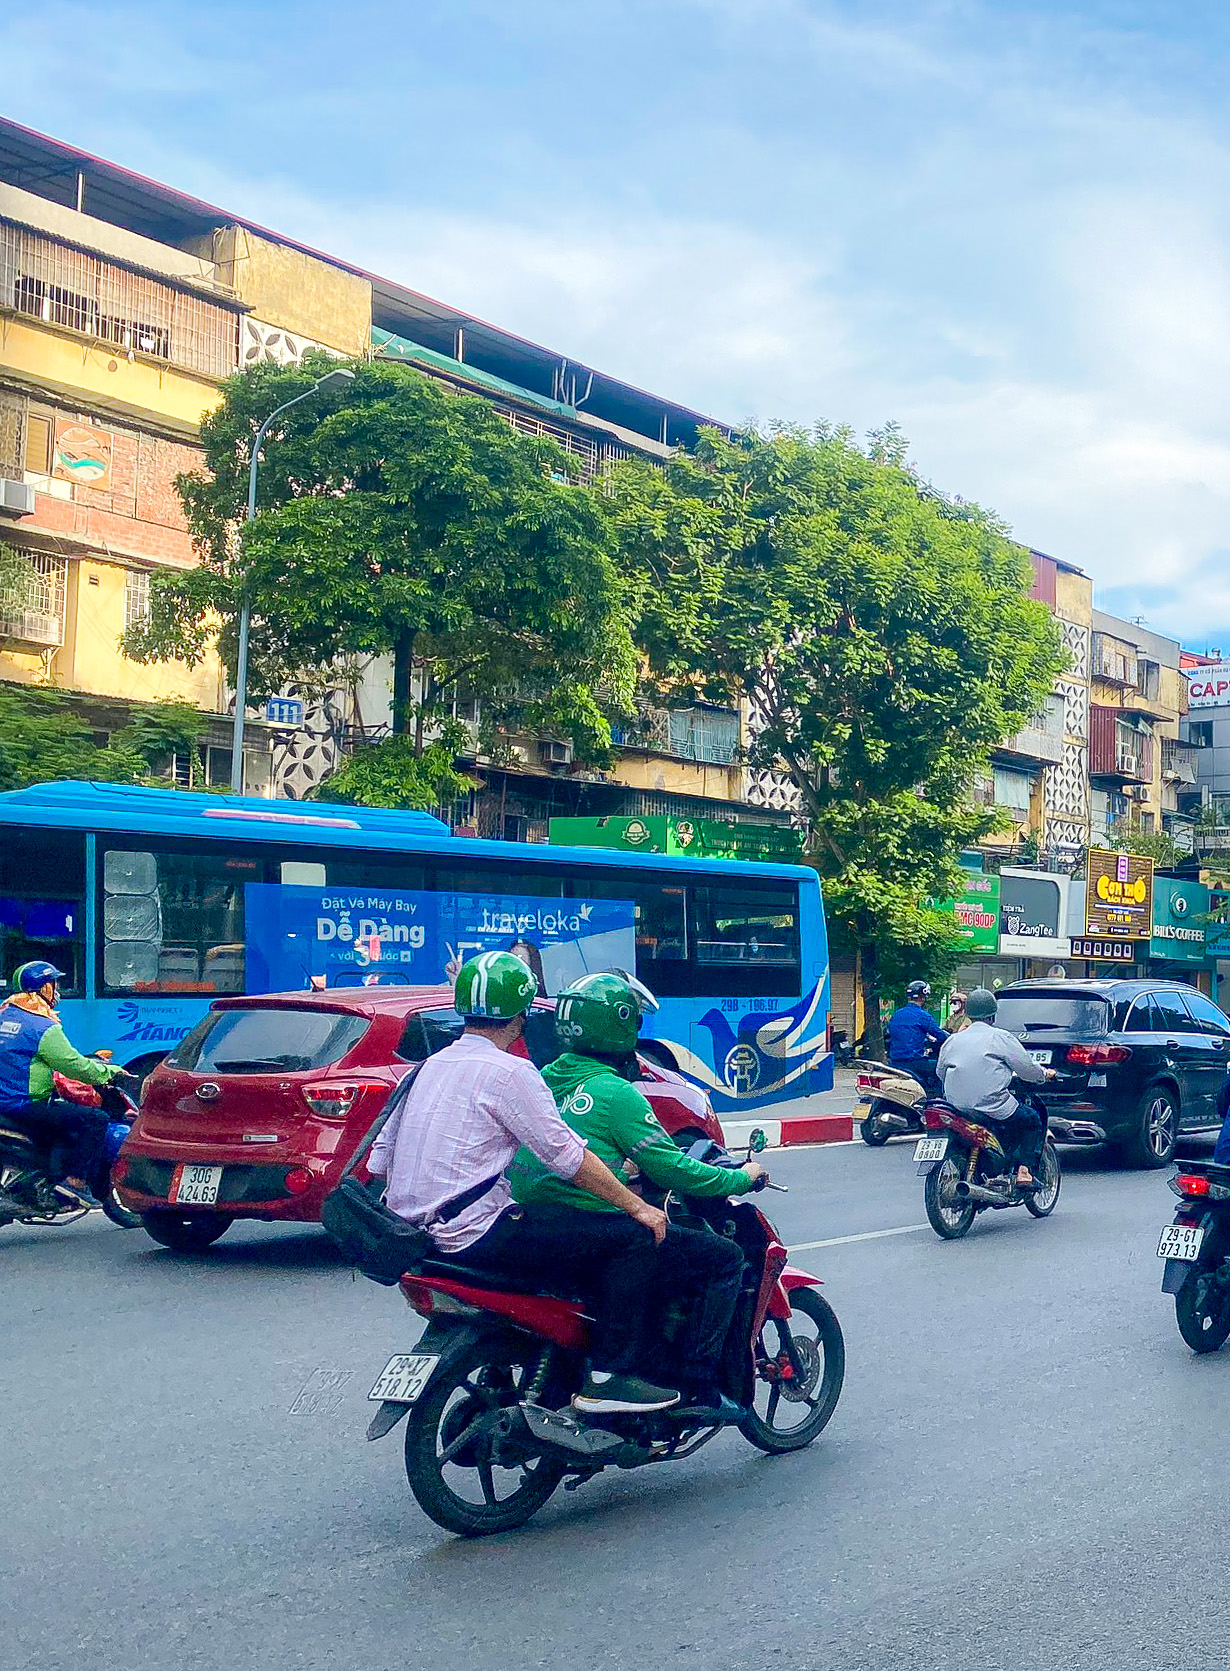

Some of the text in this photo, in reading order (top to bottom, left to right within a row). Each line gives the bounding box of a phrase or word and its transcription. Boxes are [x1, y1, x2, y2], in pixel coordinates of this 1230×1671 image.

[271, 702, 298, 724] 111
[367, 897, 392, 912] Máy
[395, 899, 417, 915] Bay
[482, 907, 581, 933] traveloka
[317, 910, 426, 949] Dễ Dàng
[1020, 922, 1053, 937] ZangTee
[1175, 927, 1205, 942] COFFEE
[720, 998, 739, 1012] 29B
[189, 1167, 213, 1184] 30G
[177, 1184, 218, 1203] 424.63
[1166, 1228, 1197, 1243] 29-G1
[1159, 1242, 1197, 1258] 973.13
[372, 1377, 422, 1399] 518.12
